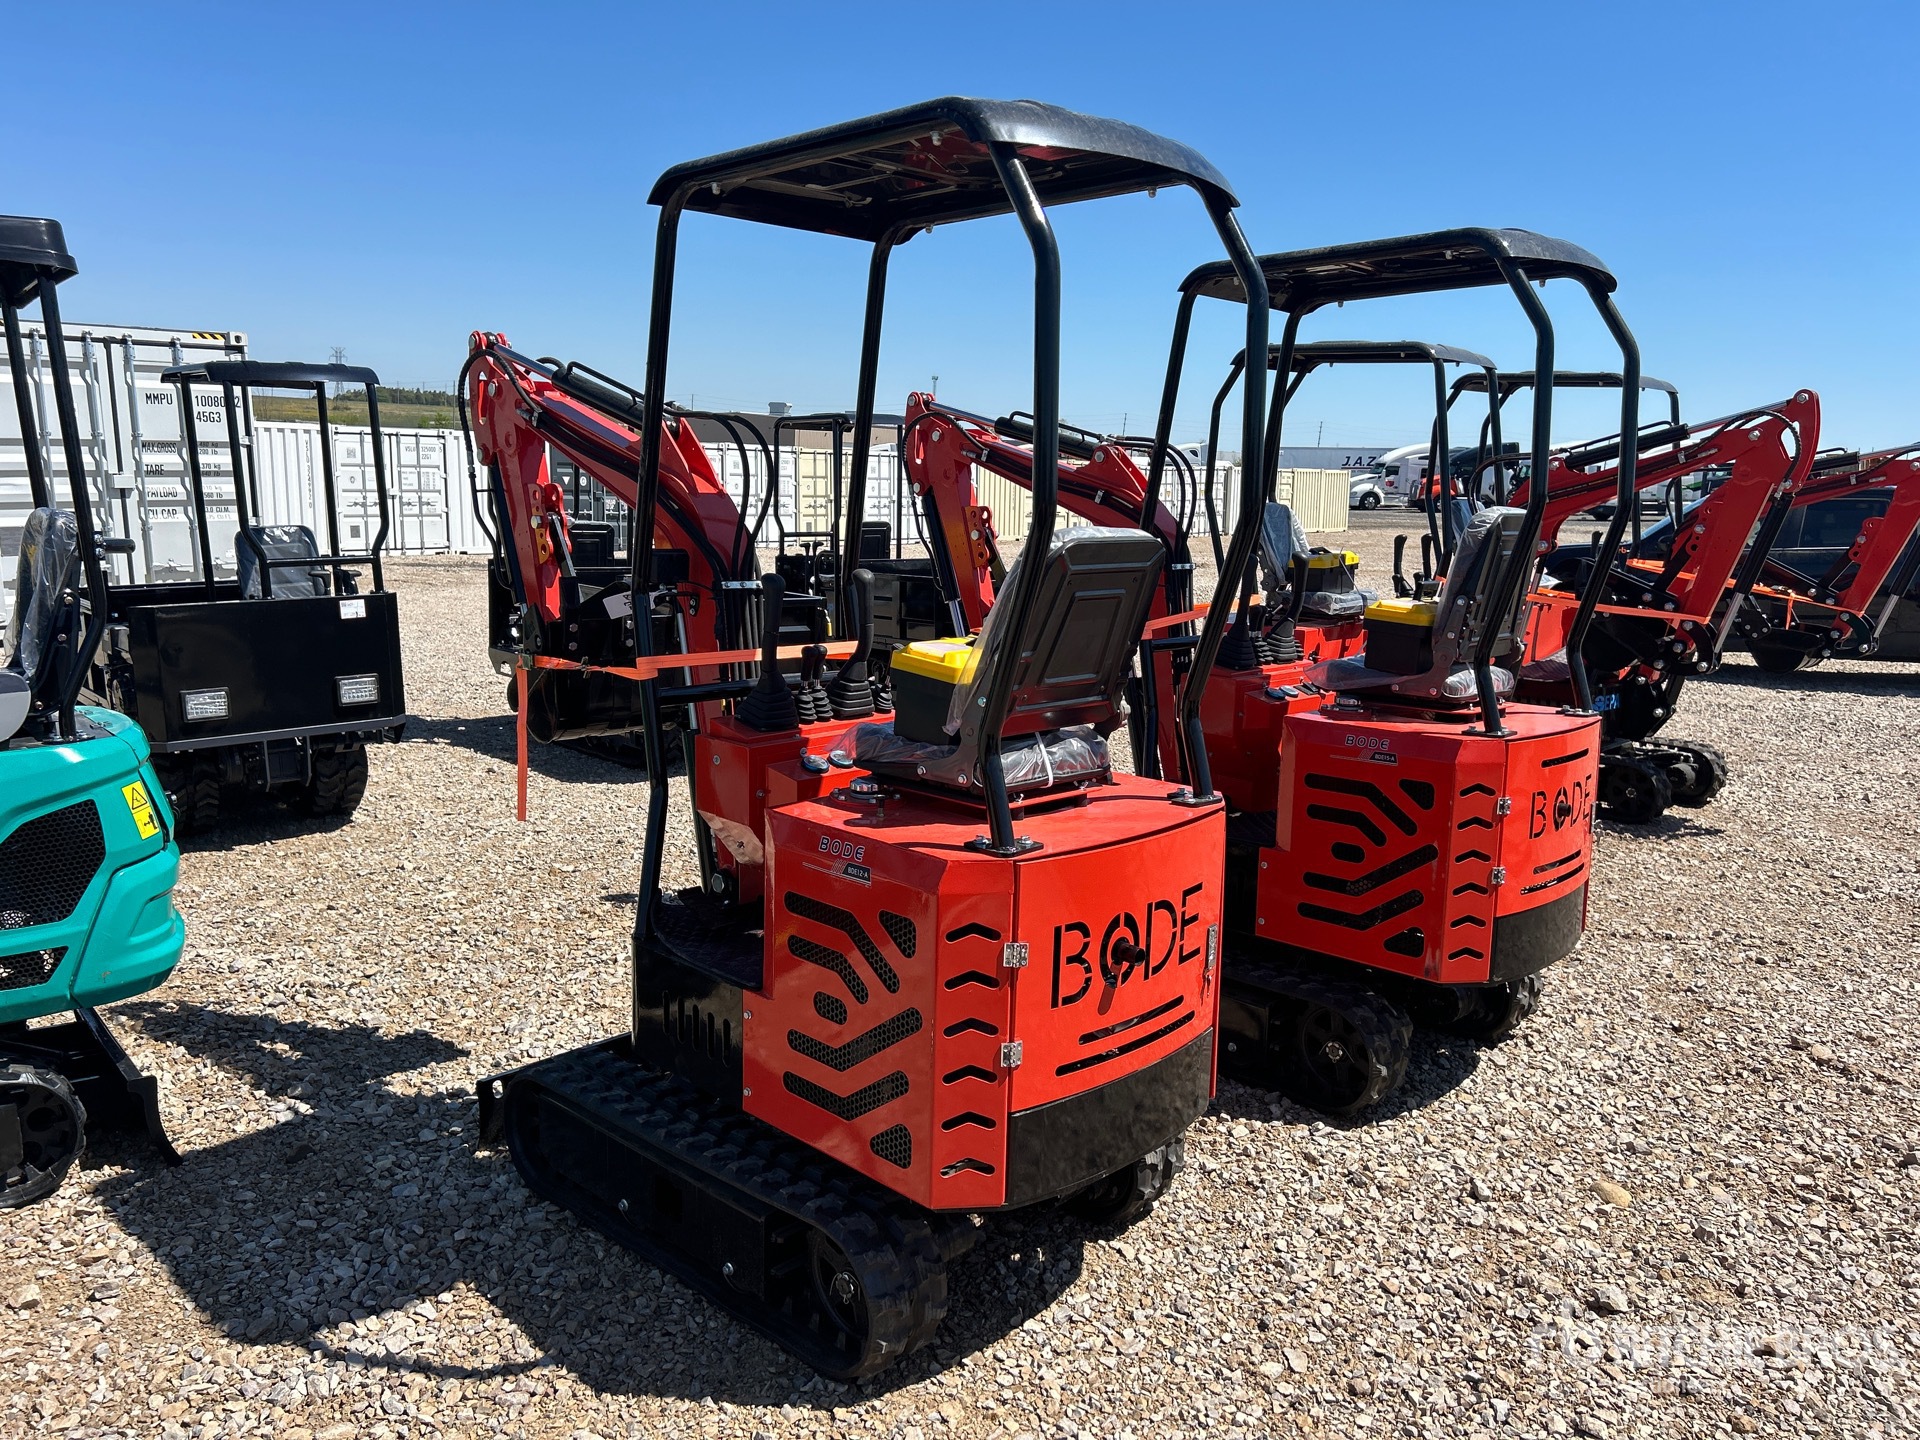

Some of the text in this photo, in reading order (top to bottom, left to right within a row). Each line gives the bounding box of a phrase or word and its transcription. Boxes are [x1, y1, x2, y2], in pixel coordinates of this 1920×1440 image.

[145, 393, 173, 405] MMPU
[195, 395, 226, 408] 10080
[196, 411, 222, 423] 45G3
[1342, 455, 1378, 467] J.A.Z
[145, 464, 164, 476] TARE
[146, 487, 178, 498] PAYLOAD
[1345, 734, 1390, 751] BODE
[1529, 774, 1592, 839] BODE
[818, 835, 866, 863] BODE
[1051, 881, 1204, 1010] BODE
